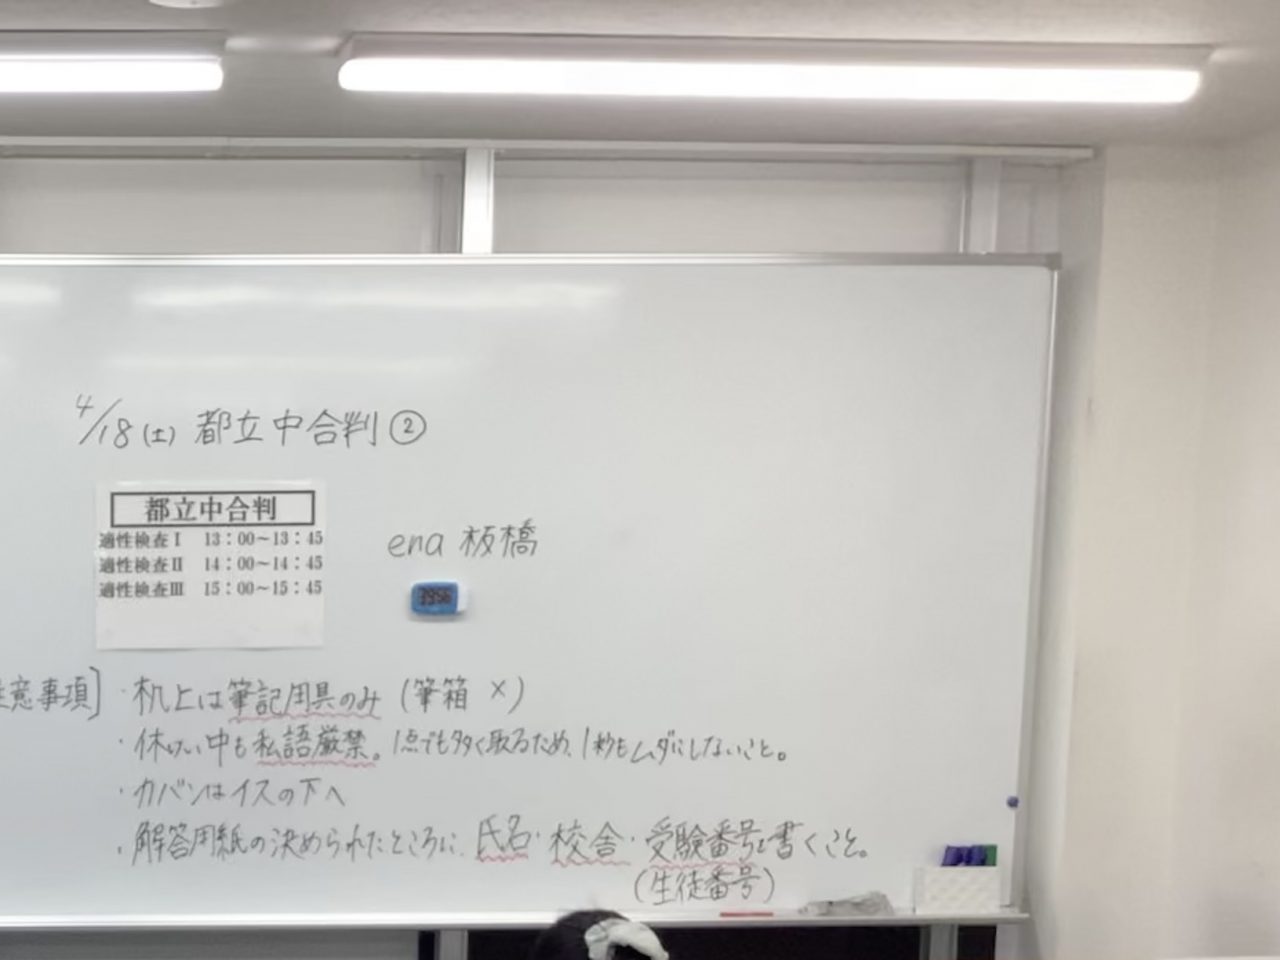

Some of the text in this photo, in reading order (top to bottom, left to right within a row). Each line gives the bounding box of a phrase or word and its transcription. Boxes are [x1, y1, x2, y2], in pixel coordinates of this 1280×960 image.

[145, 496, 277, 523] 都立中合判
[388, 519, 538, 559] ena 板橋
